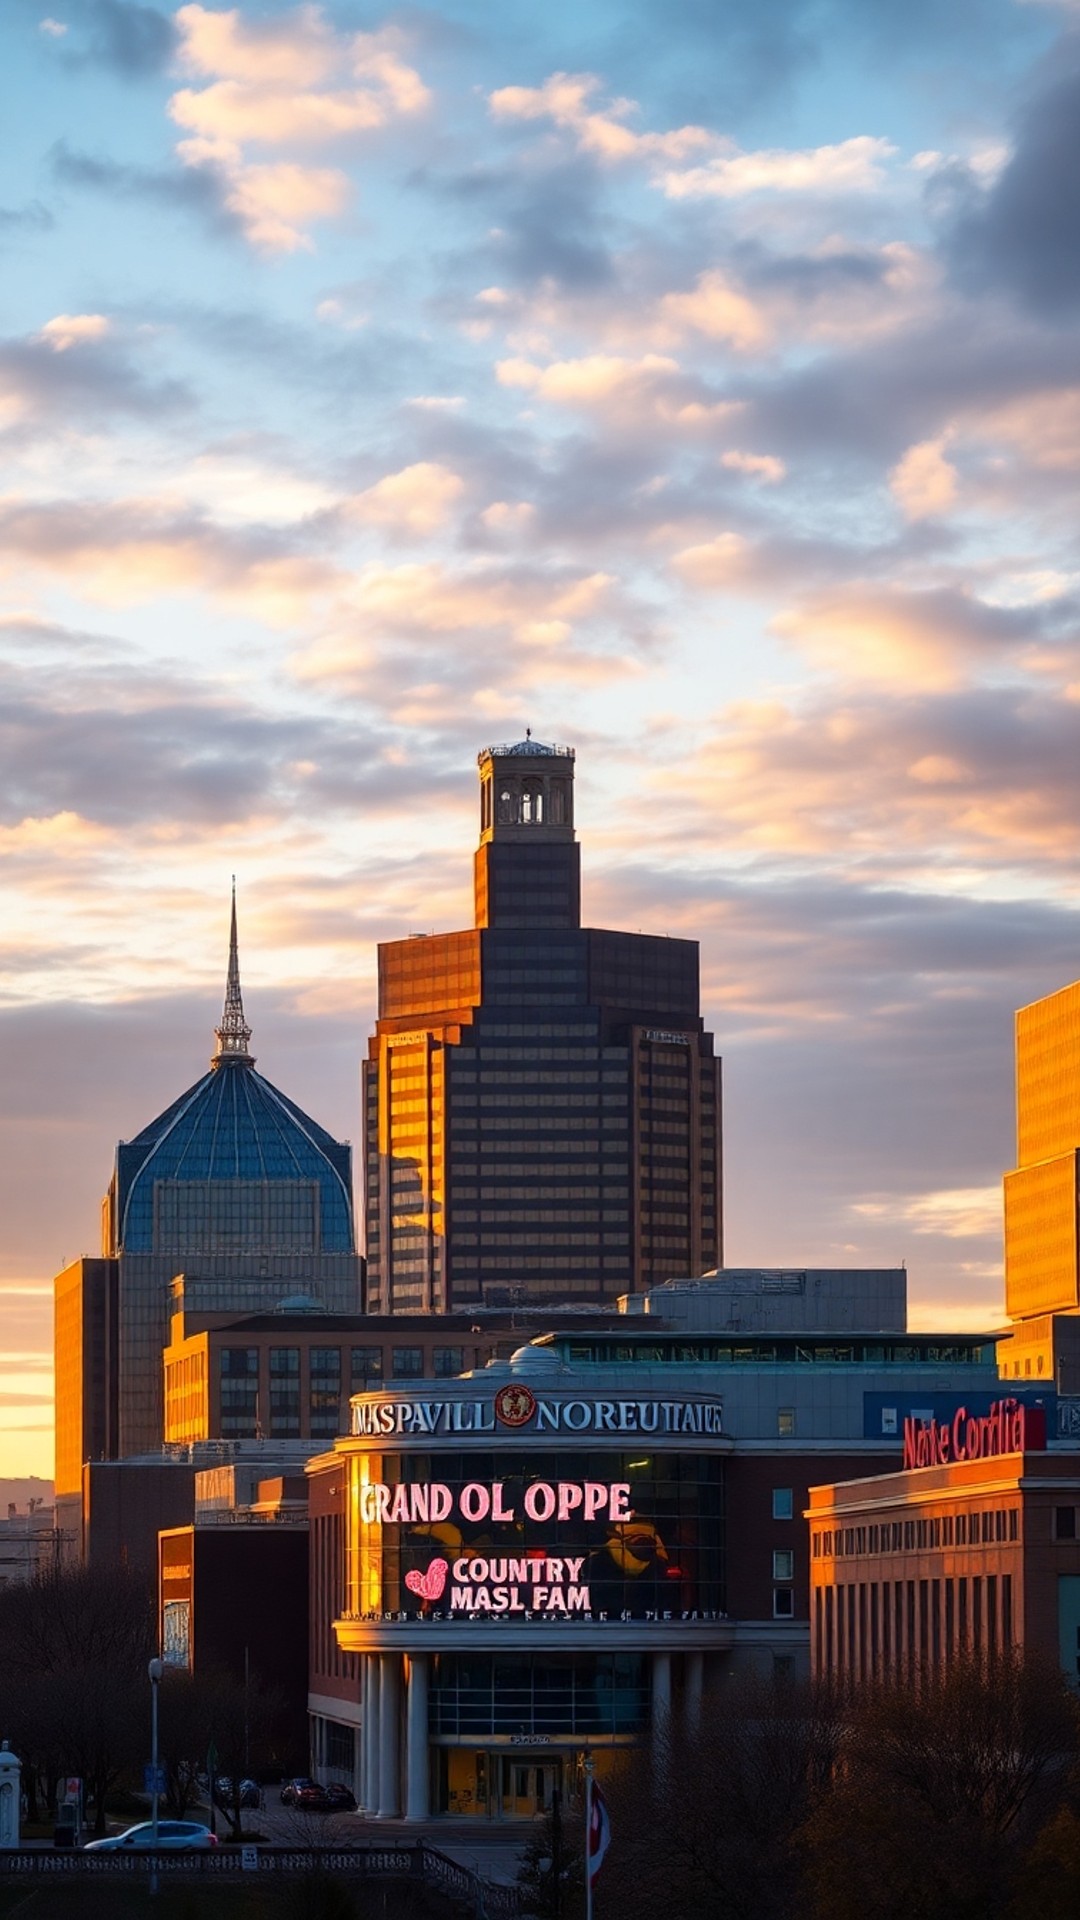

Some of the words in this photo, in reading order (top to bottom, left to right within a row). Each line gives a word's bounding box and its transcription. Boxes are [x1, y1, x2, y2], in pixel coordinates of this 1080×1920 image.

[360, 1483, 453, 1524] GRAND
[459, 1483, 515, 1522] OL
[524, 1483, 632, 1522] OPPE
[453, 1558, 586, 1583] COUNTRY
[450, 1586, 525, 1611] MASL
[532, 1586, 592, 1611] FAM
